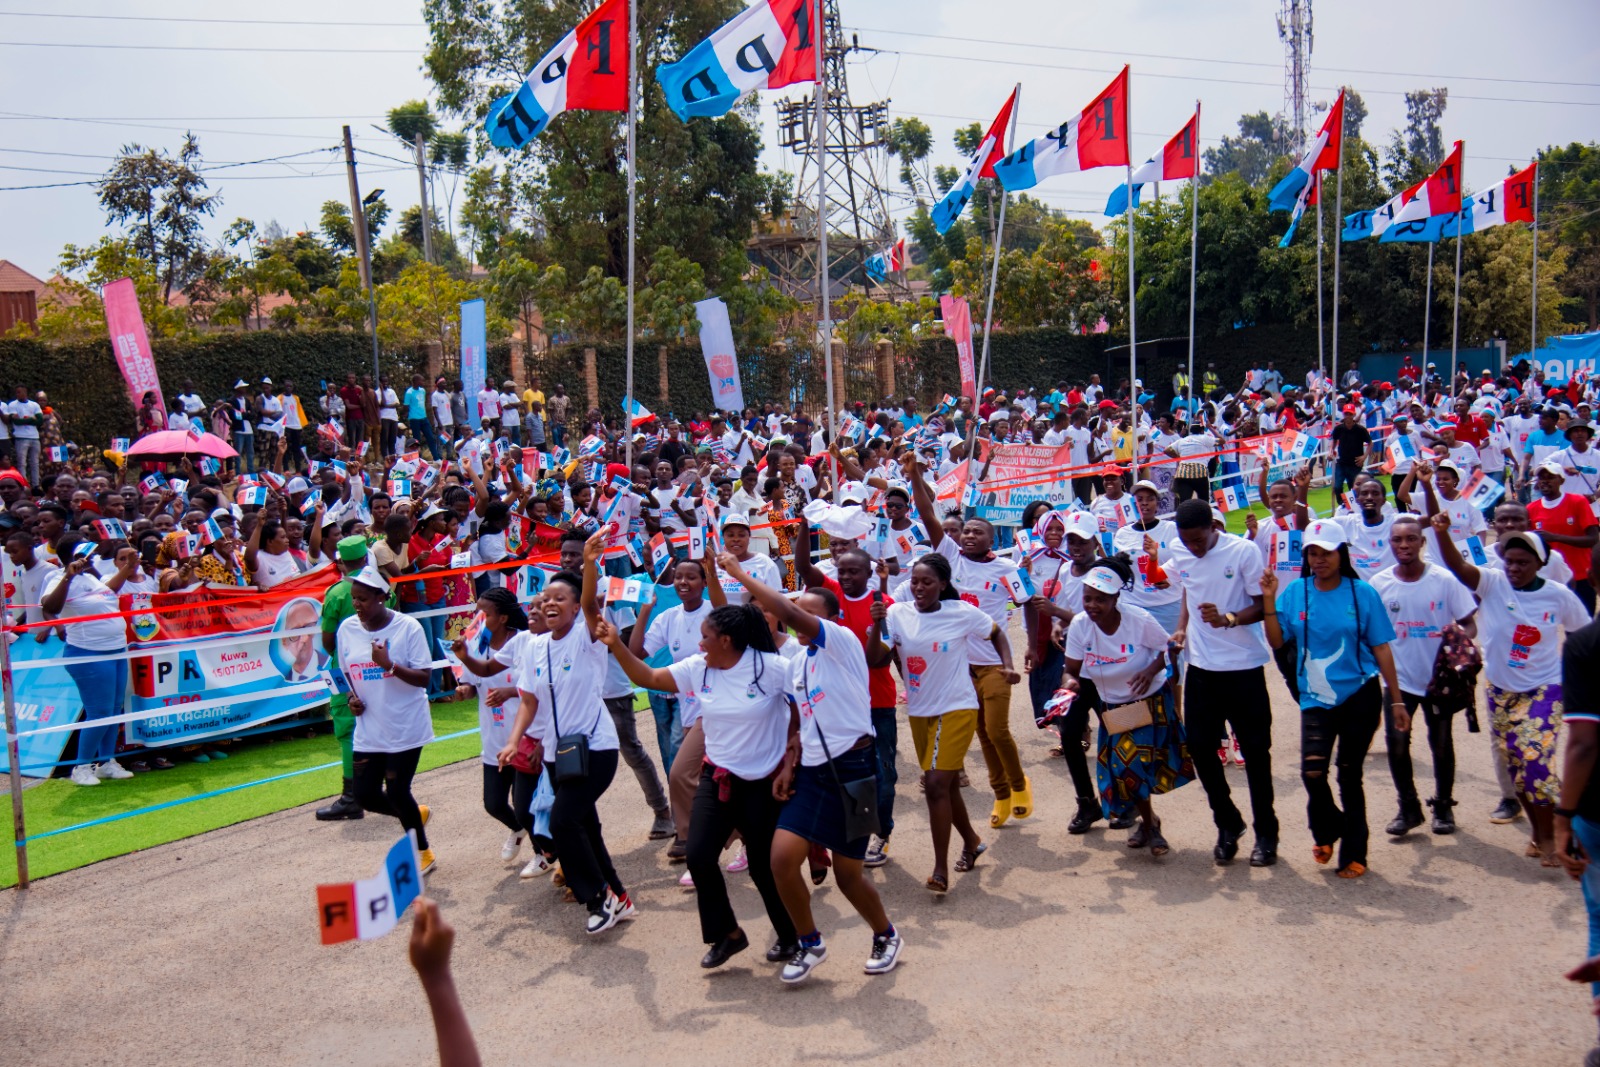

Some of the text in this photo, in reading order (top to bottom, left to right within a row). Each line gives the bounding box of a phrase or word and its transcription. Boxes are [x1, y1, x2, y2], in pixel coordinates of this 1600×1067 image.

[1216, 490, 1247, 508] FPR
[220, 650, 248, 663] Kuwa
[212, 659, 263, 678] 15/07/2024
[363, 673, 384, 682] PAUL
[176, 705, 231, 722] KAGAME
[183, 720, 220, 732] Rwanda
[323, 861, 412, 928] FPR
